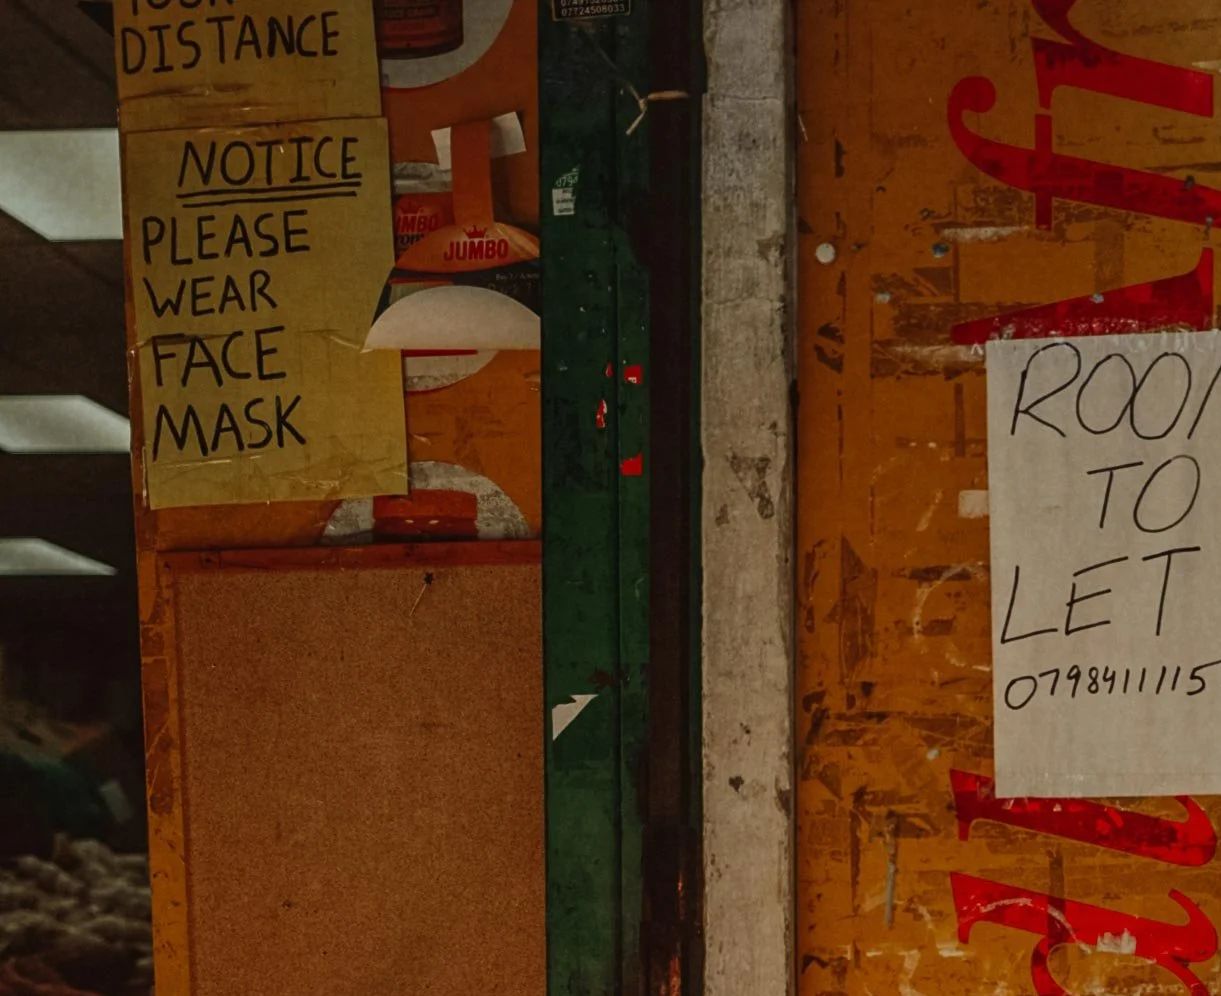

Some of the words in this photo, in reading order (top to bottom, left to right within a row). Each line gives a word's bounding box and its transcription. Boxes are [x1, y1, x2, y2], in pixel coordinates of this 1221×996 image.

[121, 11, 340, 75] DISTANCE
[178, 136, 362, 187] NOTICE
[142, 209, 311, 265] PLEASE
[444, 238, 509, 261] JUMBO
[142, 269, 278, 318] WEAR
[151, 325, 287, 388] FACE
[152, 394, 307, 462] MASK
[1087, 454, 1201, 533] TO
[1001, 545, 1201, 645] LET
